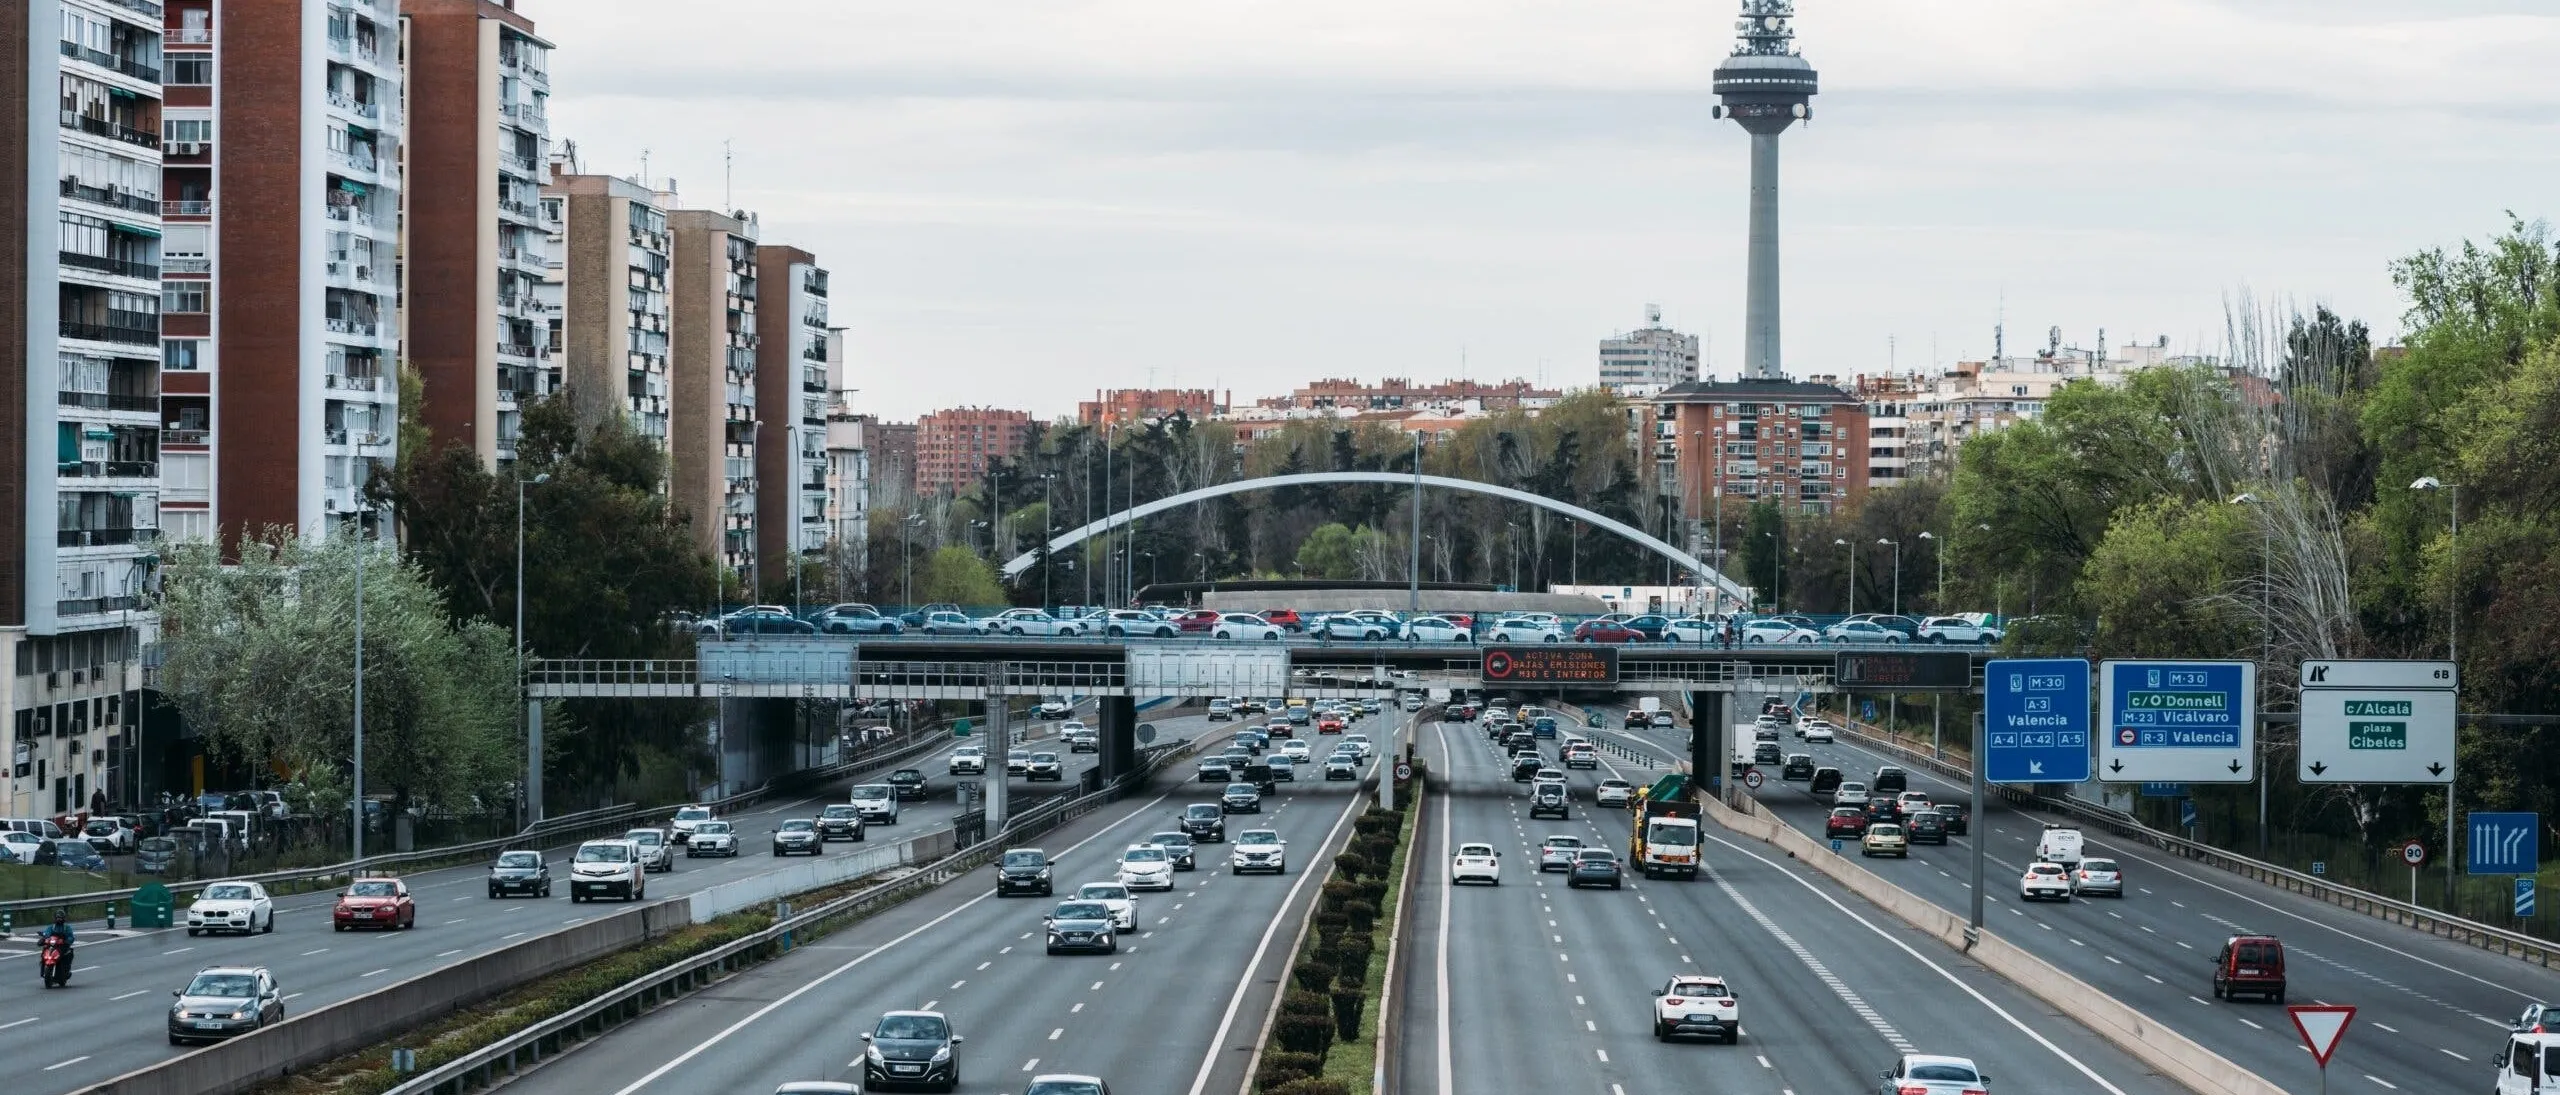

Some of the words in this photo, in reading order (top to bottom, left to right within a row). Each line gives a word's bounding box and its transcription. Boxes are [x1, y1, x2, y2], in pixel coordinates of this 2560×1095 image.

[1525, 651, 1562, 659] ACTIVA
[1569, 651, 1593, 659] ZONA
[1513, 661, 1544, 669] BAJAS
[1550, 661, 1606, 669] EMISIONES
[1519, 670, 1537, 678] M30
[1544, 670, 1550, 678] E
[1556, 670, 1606, 678] INTERIOR
[2171, 674, 2205, 684] M-30
[2433, 670, 2450, 679] 6B
[2031, 678, 2063, 688] M-30
[2027, 700, 2047, 710] A-3
[2131, 694, 2223, 707] c/O'Donnell
[2346, 702, 2410, 715] c/Alcalá
[2007, 714, 2068, 726] Valencia
[2123, 713, 2154, 723] M-23
[2163, 711, 2229, 723] Vicálvaro
[2363, 723, 2392, 734] plaza
[1993, 735, 2014, 745] A-4
[2023, 735, 2051, 745] A-42
[2061, 734, 2081, 744] A-5
[2143, 733, 2164, 743] R-3
[2173, 731, 2234, 743] Valencia
[2351, 736, 2405, 748] Cibeles
[2407, 848, 2422, 858] 90
